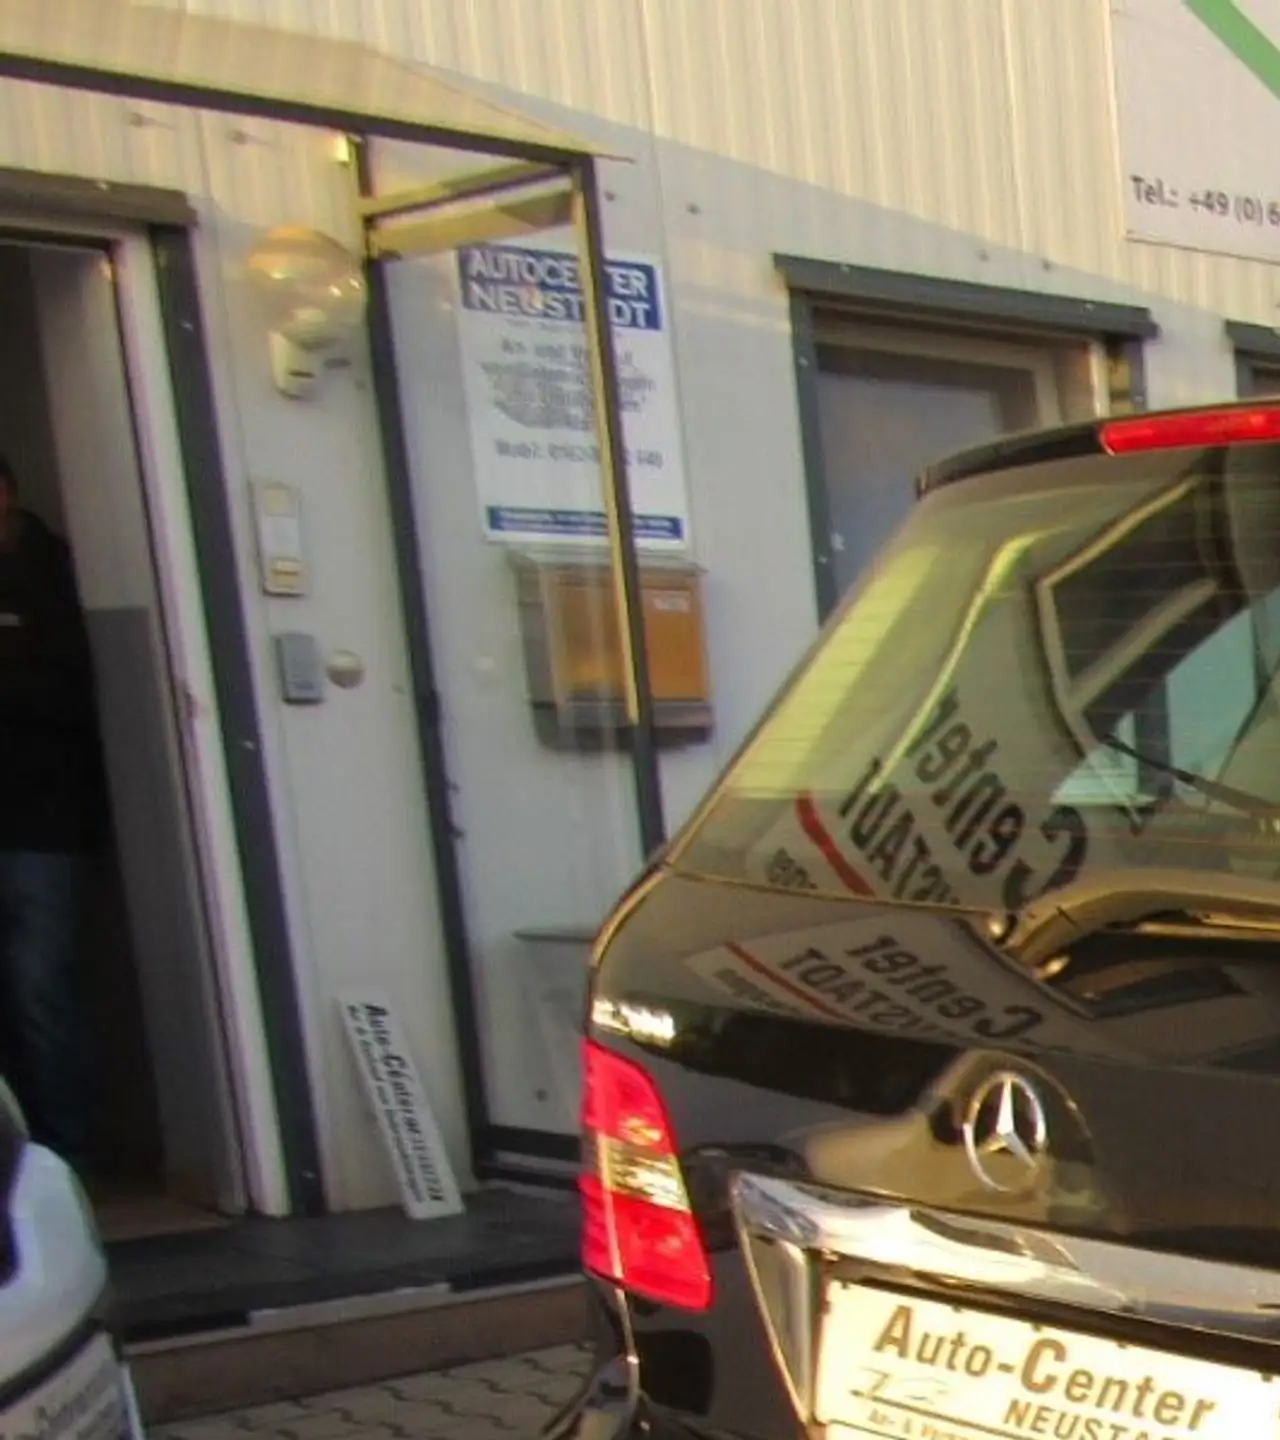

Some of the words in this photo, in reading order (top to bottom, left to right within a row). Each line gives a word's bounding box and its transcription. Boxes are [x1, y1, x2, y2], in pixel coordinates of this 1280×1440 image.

[1130, 175, 1179, 208] Tel.:
[1188, 190, 1230, 216] +49
[1234, 196, 1264, 226] (0)
[469, 248, 648, 298] AUTOCEER
[470, 280, 650, 328] NEUSTDT
[872, 1304, 1217, 1431] Auto-Center
